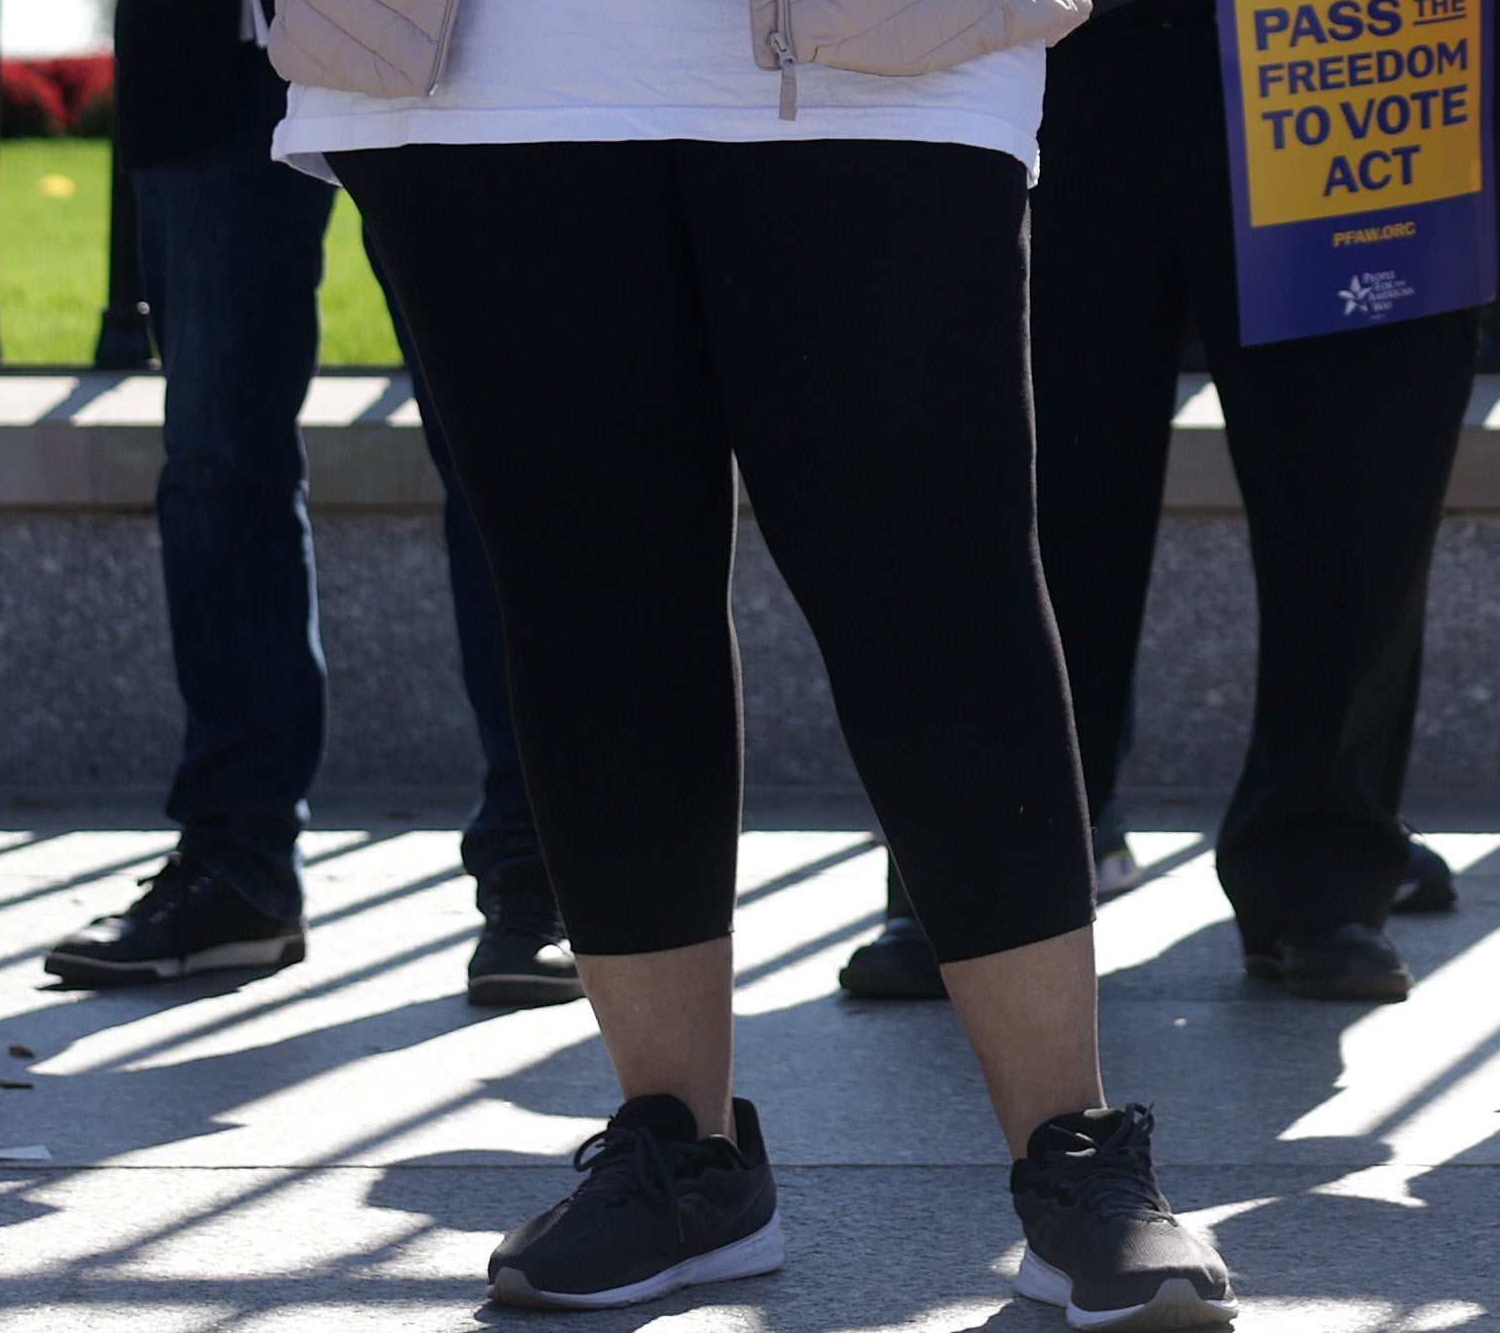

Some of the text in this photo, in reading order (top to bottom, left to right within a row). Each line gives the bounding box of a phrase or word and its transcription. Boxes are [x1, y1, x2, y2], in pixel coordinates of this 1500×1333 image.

[1258, 38, 1468, 98] FREEDOM
[1261, 83, 1468, 150] TO VOTE
[1322, 144, 1420, 197] ACT
